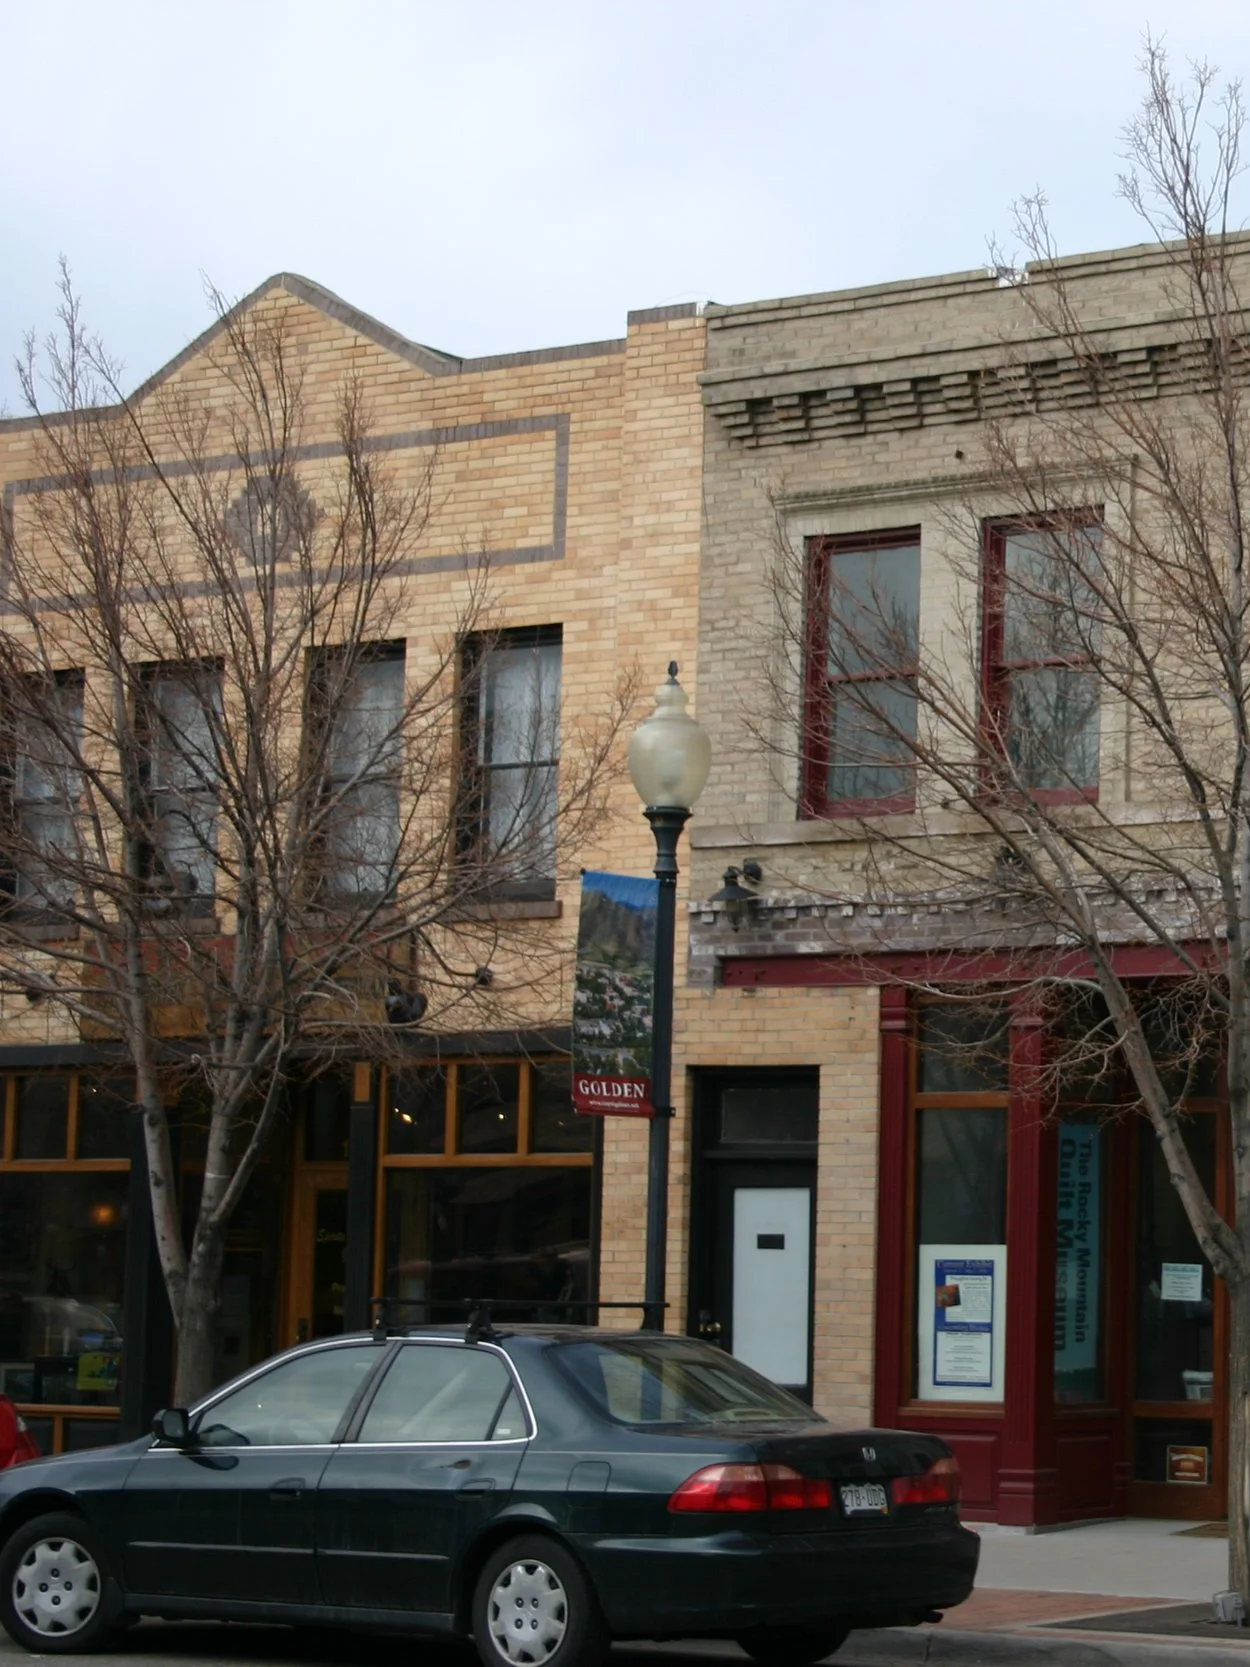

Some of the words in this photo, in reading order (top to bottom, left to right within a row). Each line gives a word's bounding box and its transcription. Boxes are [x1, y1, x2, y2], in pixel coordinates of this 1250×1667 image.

[579, 1079, 645, 1098] GOLDEN
[1059, 1138, 1077, 1210] Quilt
[1078, 1139, 1092, 1176] The
[1074, 1182, 1092, 1242] Rocky
[1054, 1219, 1075, 1351] Museum
[1075, 1248, 1092, 1343] Mountain
